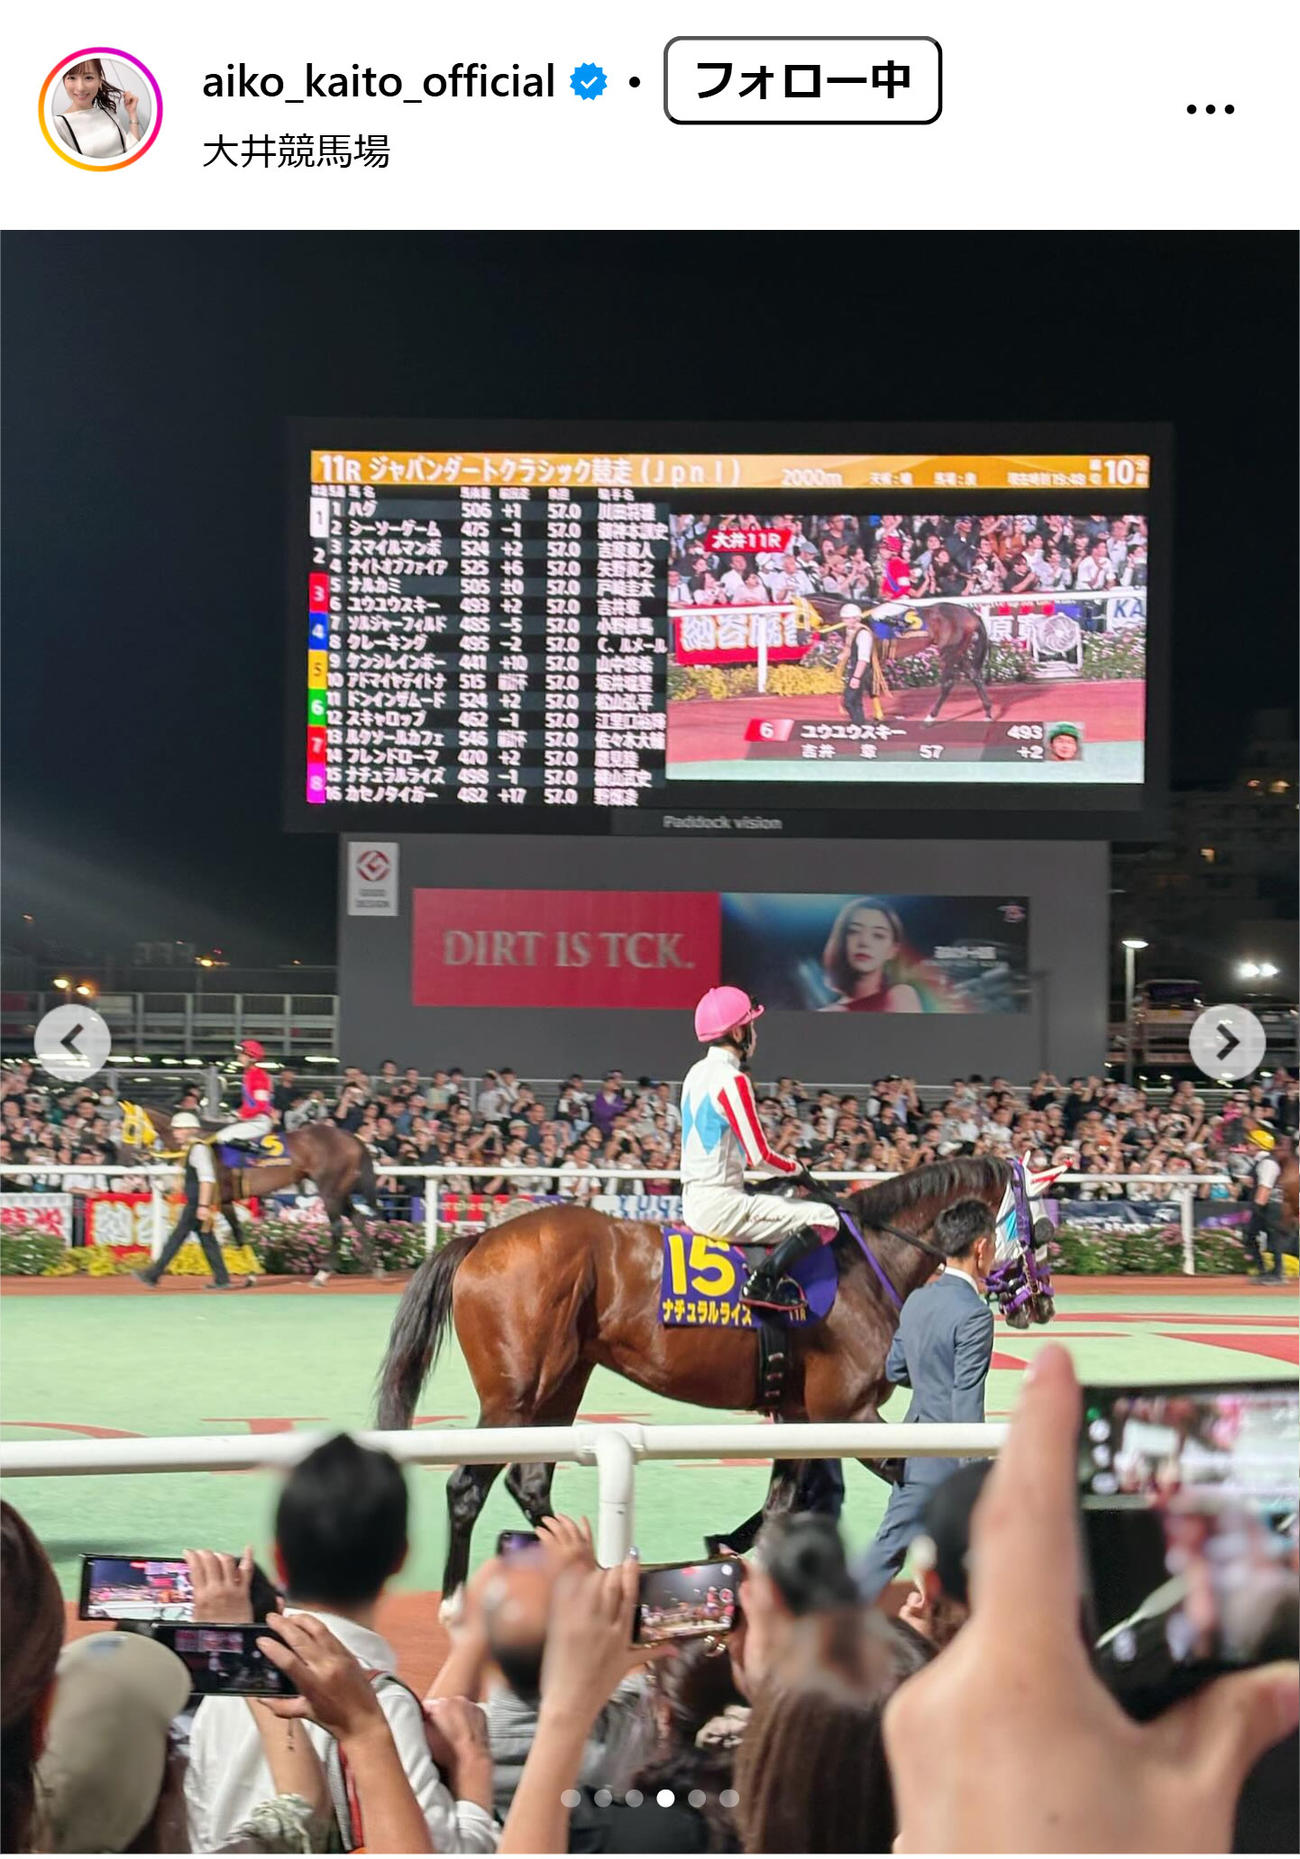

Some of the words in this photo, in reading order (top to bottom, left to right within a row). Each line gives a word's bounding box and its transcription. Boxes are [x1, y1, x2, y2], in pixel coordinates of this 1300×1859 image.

[320, 455, 361, 481] 11R
[781, 468, 842, 486] 2000m
[1104, 459, 1135, 485] 10
[332, 502, 341, 516] 1
[548, 503, 581, 519] 57.0
[331, 520, 342, 535] 2
[350, 520, 441, 537] シーソーゲーム
[548, 522, 581, 538] 57.0
[330, 539, 342, 554] 3
[547, 541, 581, 557] 57.0
[712, 532, 781, 549] 大井11R
[313, 547, 325, 564] 2
[330, 558, 342, 573] 4
[548, 561, 580, 576] 57.0
[313, 586, 325, 602] 3
[330, 577, 341, 592] 5
[547, 579, 580, 595] 57.0
[330, 596, 341, 611] 6
[547, 599, 580, 614] 57.0
[312, 624, 324, 639] 4
[330, 615, 341, 630] 7
[547, 618, 580, 633] 57.0
[329, 634, 341, 651] 8
[547, 637, 579, 652] 57.0
[329, 653, 341, 668] 9
[546, 656, 579, 671] 57.0
[546, 675, 579, 690] 57.0
[311, 699, 324, 715] 6
[546, 694, 579, 709] 57.0
[546, 713, 578, 728] 57.0
[759, 722, 774, 739] 6
[801, 724, 907, 740] ユウユウスキー
[1007, 724, 1043, 740] 493
[545, 732, 578, 747] 57.0
[545, 751, 578, 766] 57.0
[919, 744, 944, 759] 57
[1016, 745, 1044, 760] +2
[309, 775, 323, 790] 8
[545, 769, 578, 785] 57.0
[545, 788, 577, 804] 57.0
[663, 815, 732, 830] Paddock
[734, 815, 783, 831] vision
[443, 930, 545, 967] DIRT
[554, 931, 592, 967] IS
[599, 931, 696, 970] TCK.
[668, 1234, 736, 1297] 15
